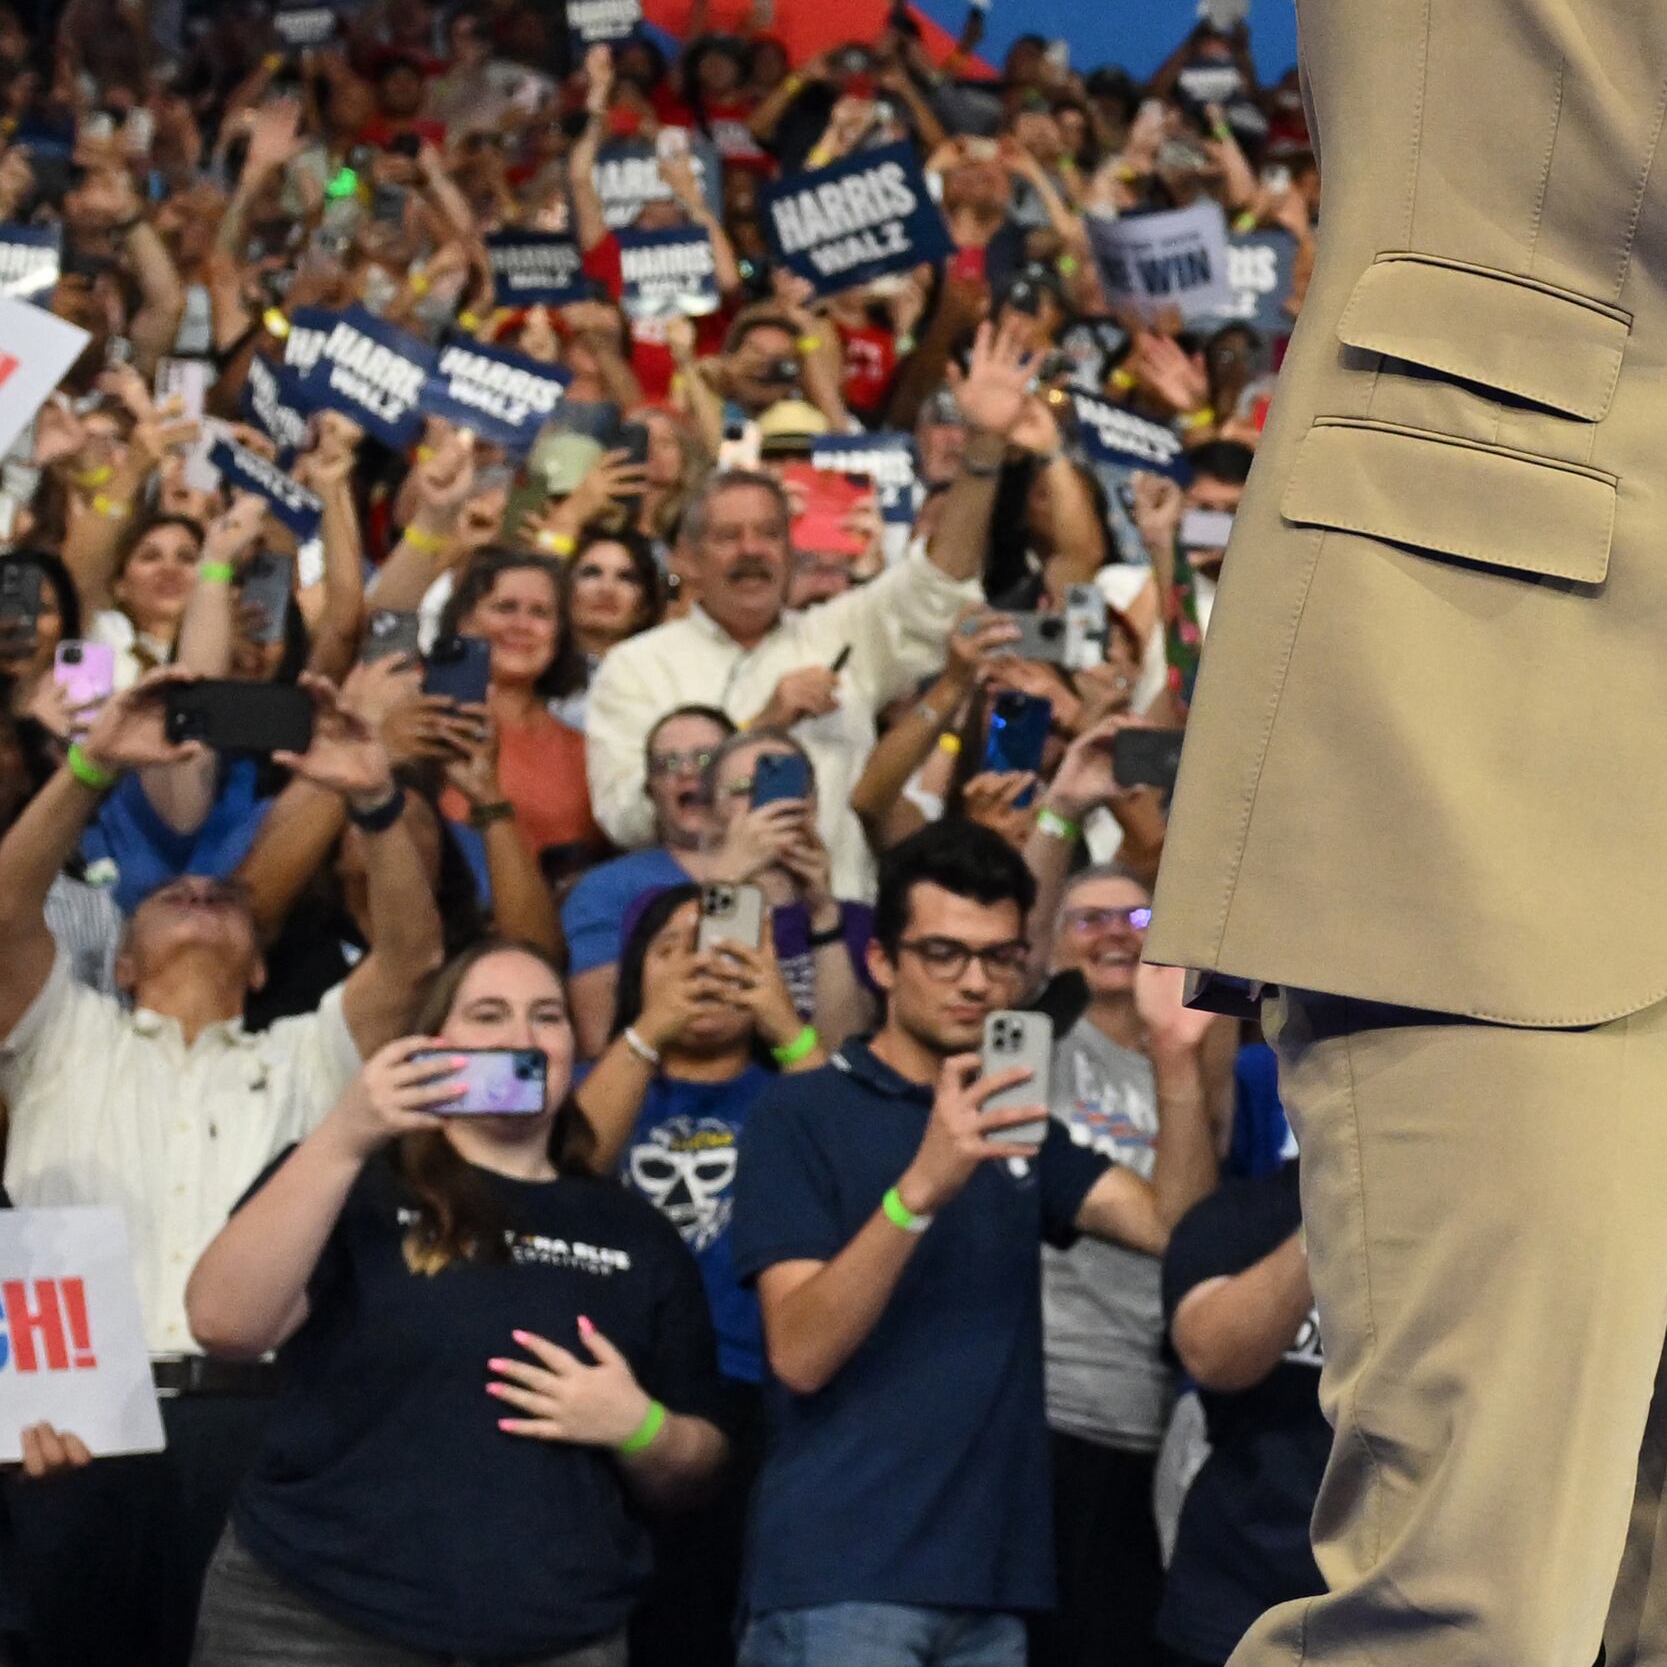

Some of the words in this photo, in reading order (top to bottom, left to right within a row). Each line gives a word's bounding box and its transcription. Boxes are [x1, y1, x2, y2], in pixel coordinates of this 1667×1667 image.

[771, 161, 918, 256] HARRIS
[809, 220, 912, 276] WALZ
[1137, 247, 1212, 297] WIN
[439, 345, 565, 413] HARRIS
[448, 375, 533, 427] WALZ
[0, 1276, 98, 1375] H!
